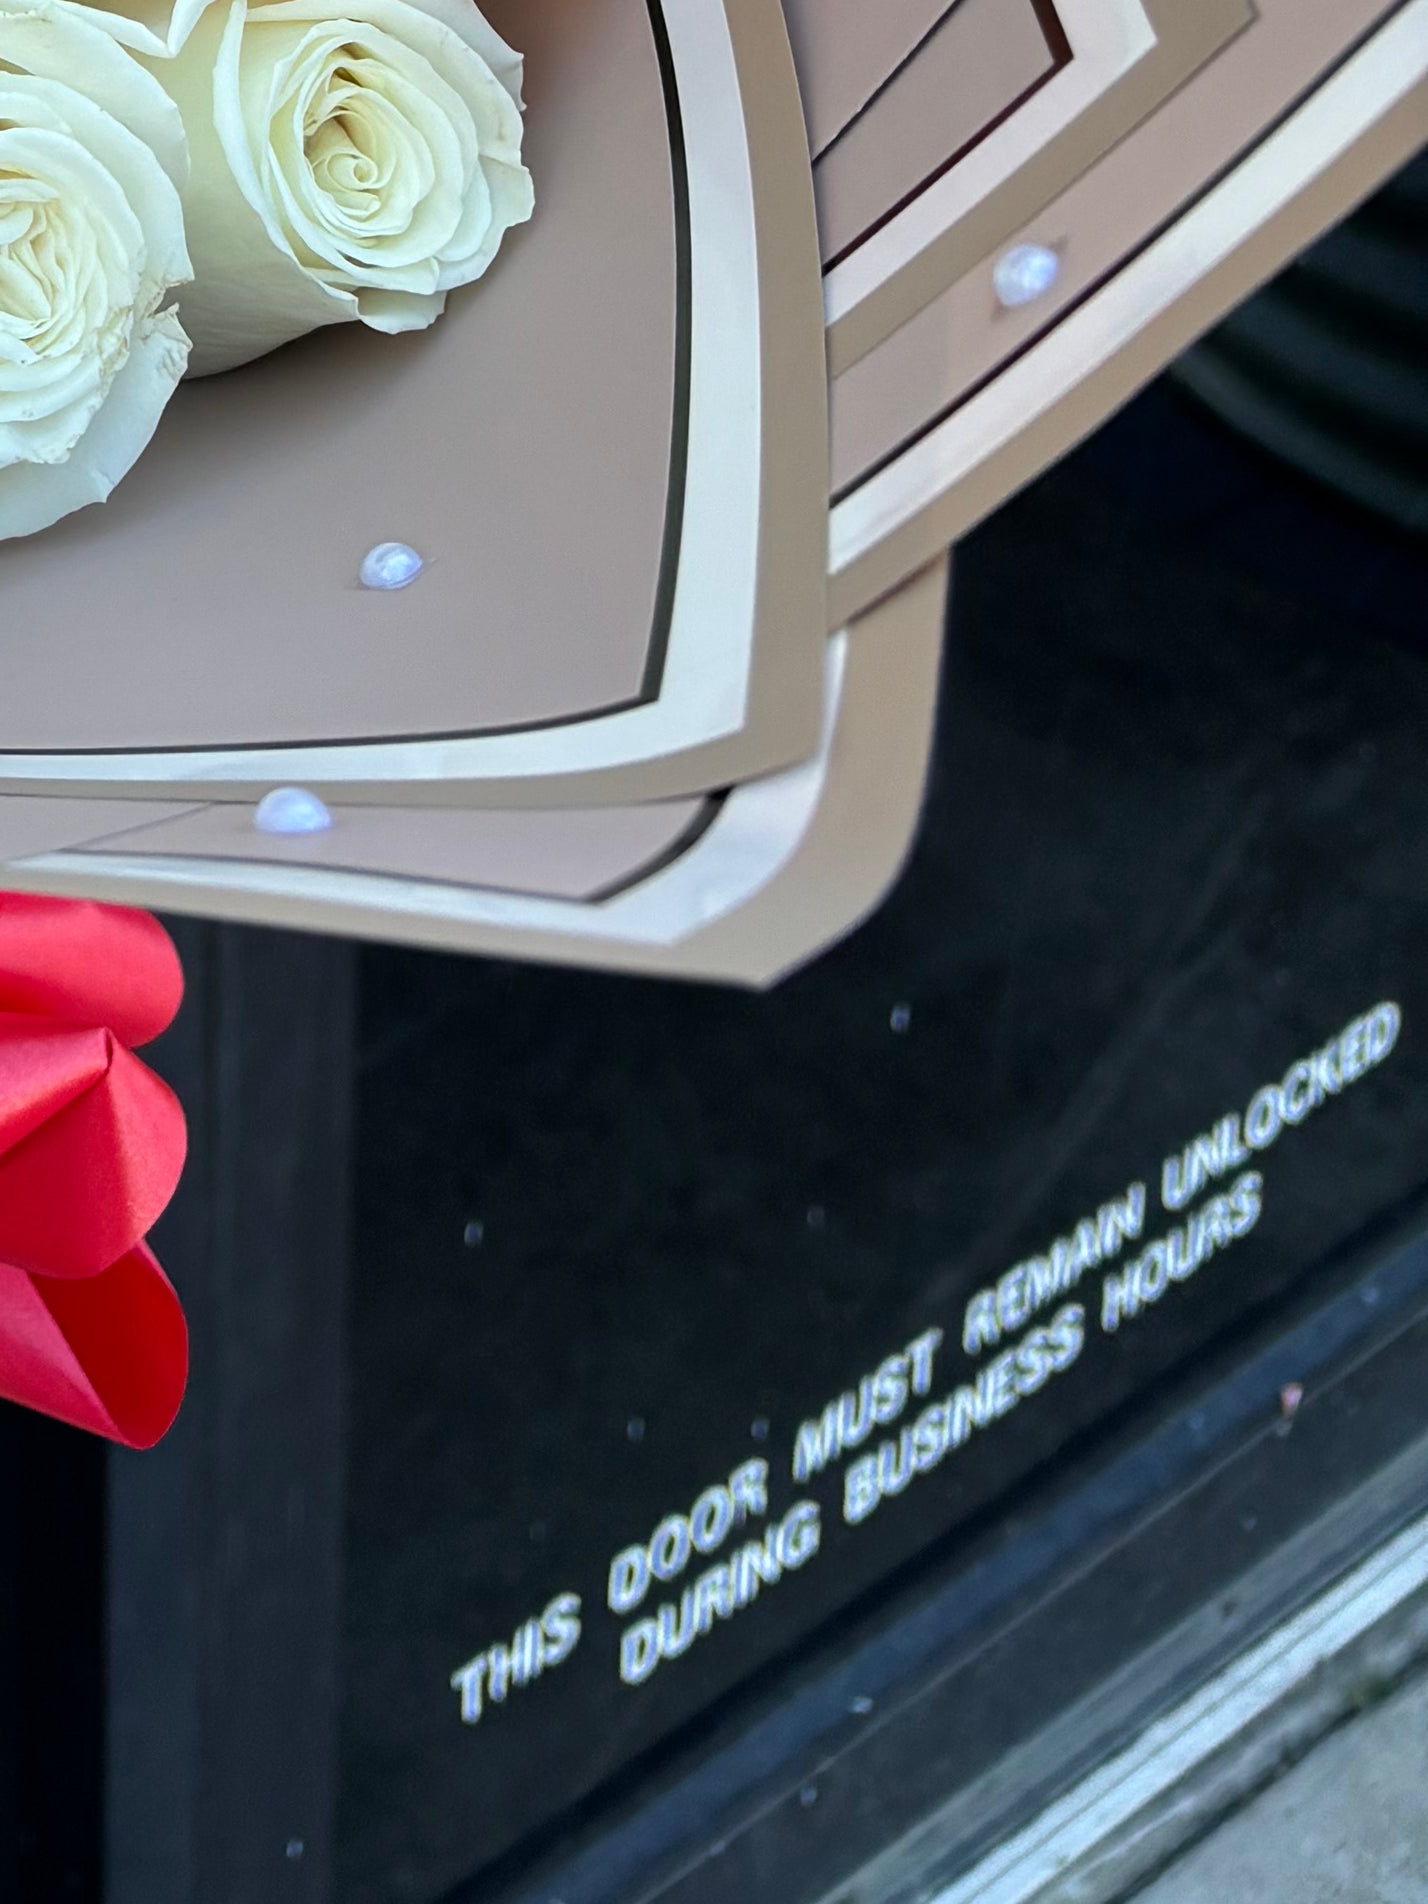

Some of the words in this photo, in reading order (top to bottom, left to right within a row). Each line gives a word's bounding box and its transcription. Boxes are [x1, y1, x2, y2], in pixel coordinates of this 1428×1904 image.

[450, 1591, 582, 1725] THIS
[607, 1457, 769, 1615] DOOR
[792, 1328, 944, 1484] MUST
[962, 1181, 1145, 1355] REMAIN
[1162, 1000, 1401, 1212] UNLOCKED
[619, 1498, 821, 1685] DURING
[842, 1302, 1086, 1525] BUSINESS
[1101, 1170, 1264, 1333] HOURS
